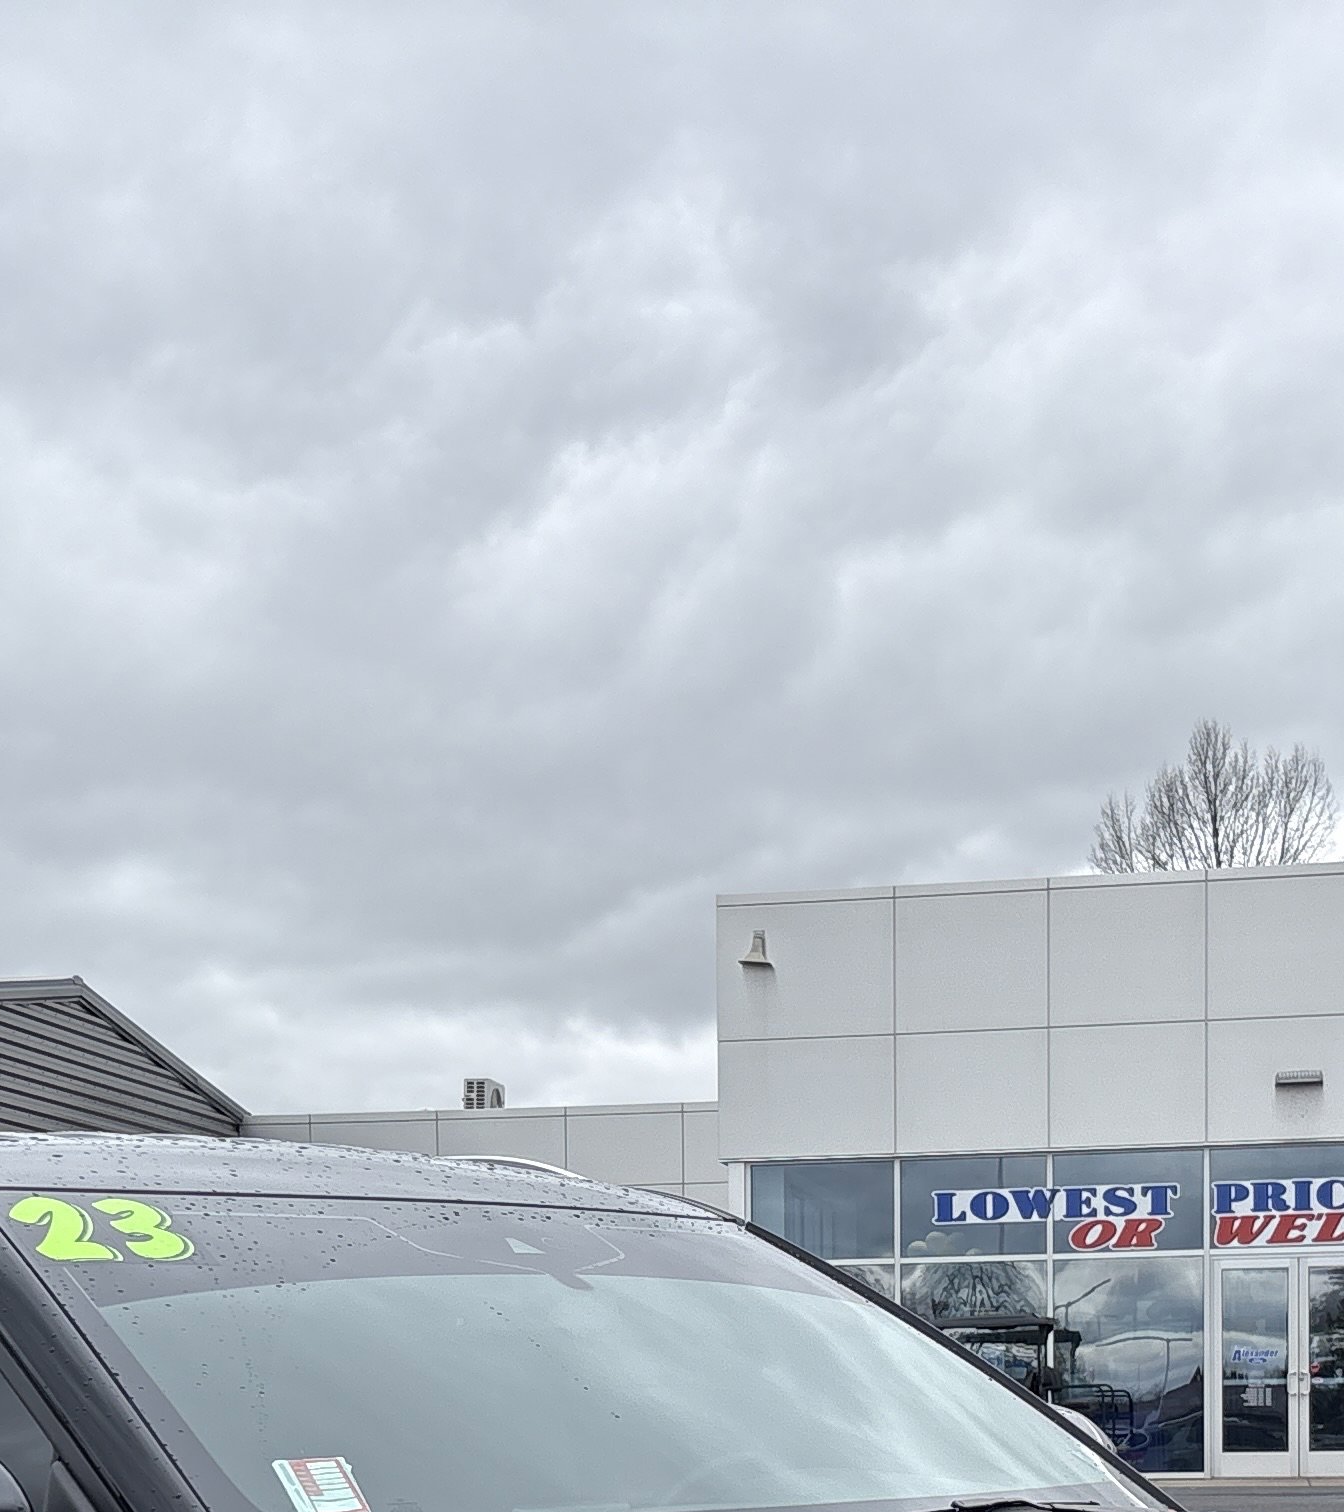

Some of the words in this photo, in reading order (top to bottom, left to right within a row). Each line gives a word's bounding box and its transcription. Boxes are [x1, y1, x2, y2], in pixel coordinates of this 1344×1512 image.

[935, 1184, 1177, 1223] LOWEST
[9, 1196, 195, 1262] 23
[1071, 1218, 1163, 1248] OR
